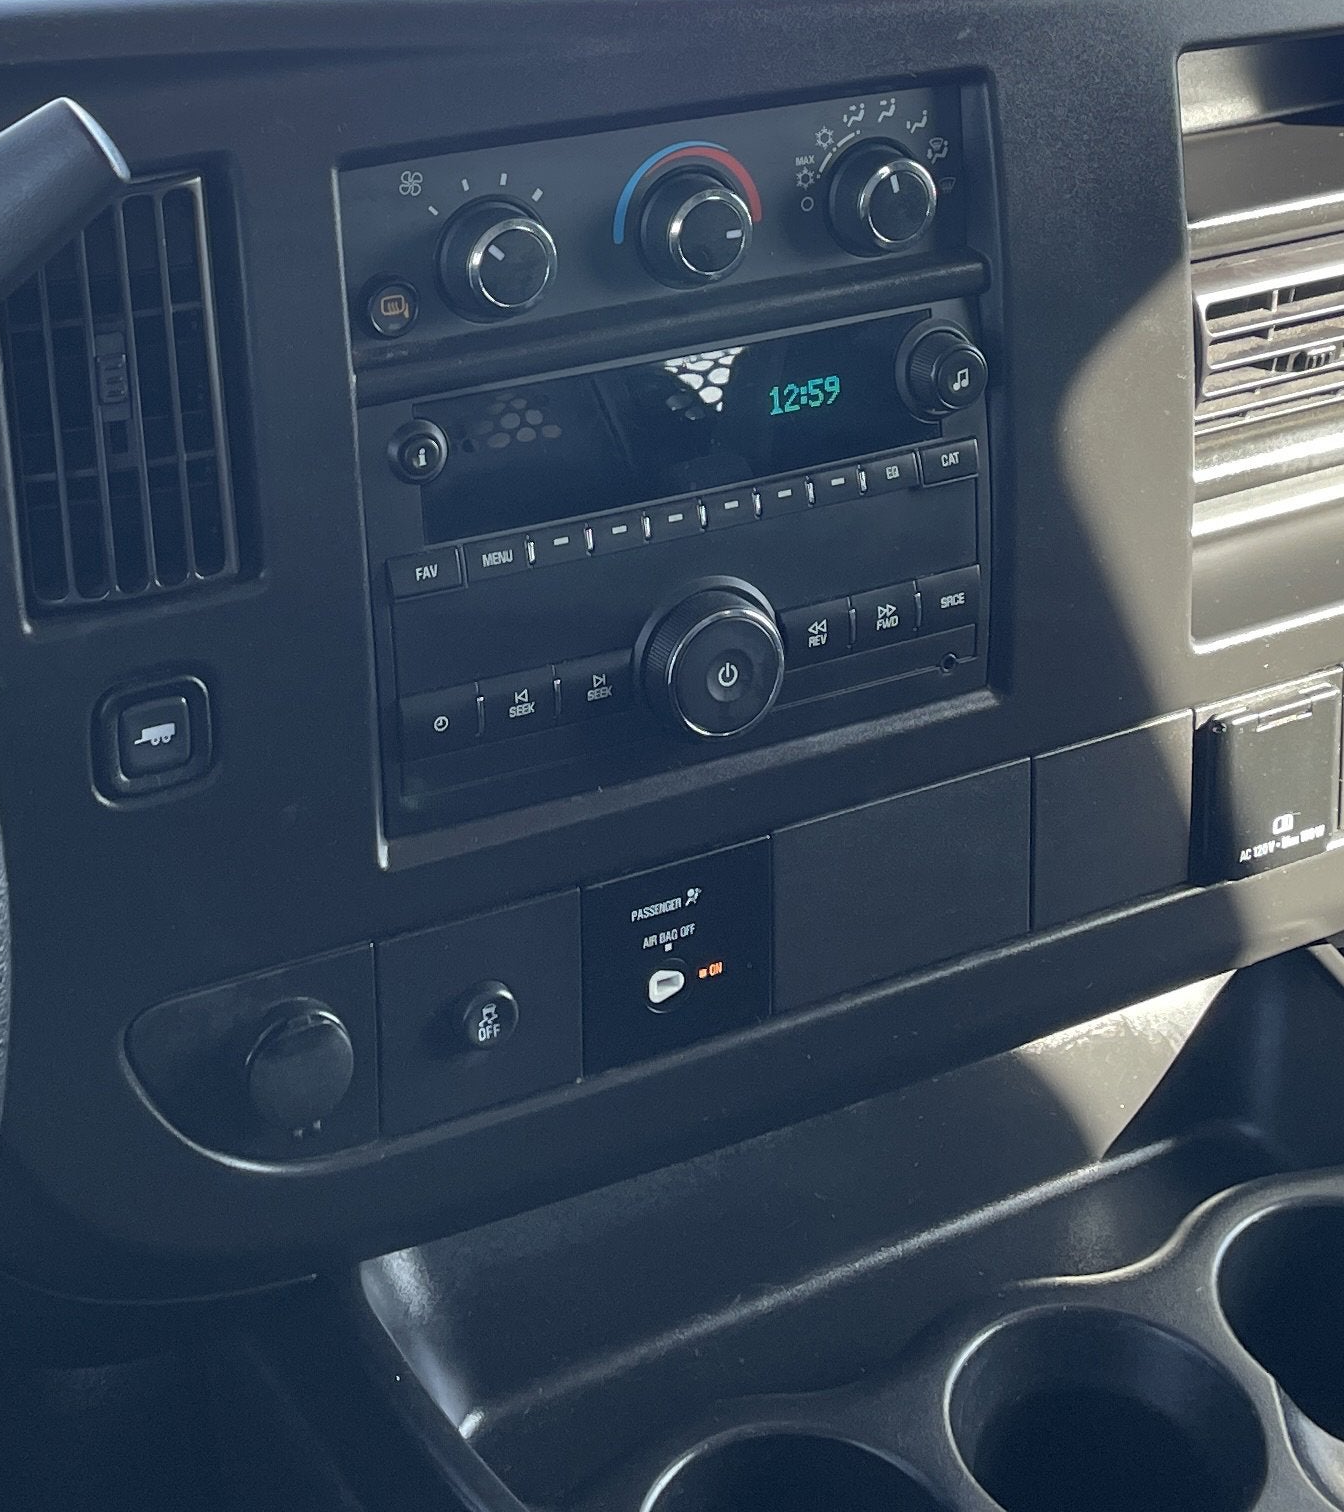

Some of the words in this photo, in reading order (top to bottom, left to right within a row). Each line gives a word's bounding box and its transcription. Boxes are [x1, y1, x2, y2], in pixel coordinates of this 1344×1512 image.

[795, 154, 816, 167] MAX
[769, 375, 841, 416] 12:59
[940, 451, 961, 468] CAT
[885, 465, 900, 481] EQ
[481, 548, 515, 569] MENU
[414, 563, 439, 581] FAV
[939, 590, 966, 610] SRCE
[874, 612, 900, 631] FWD
[806, 631, 829, 649] REV
[586, 684, 614, 702] SEEK
[508, 701, 536, 719] SEEK
[1239, 848, 1252, 863] AC
[630, 896, 683, 923] PASSENGER
[642, 934, 658, 950] AIR
[659, 928, 678, 945] BAG
[680, 922, 696, 939] OFF
[708, 960, 723, 977] ON
[476, 1022, 502, 1043] OFF
